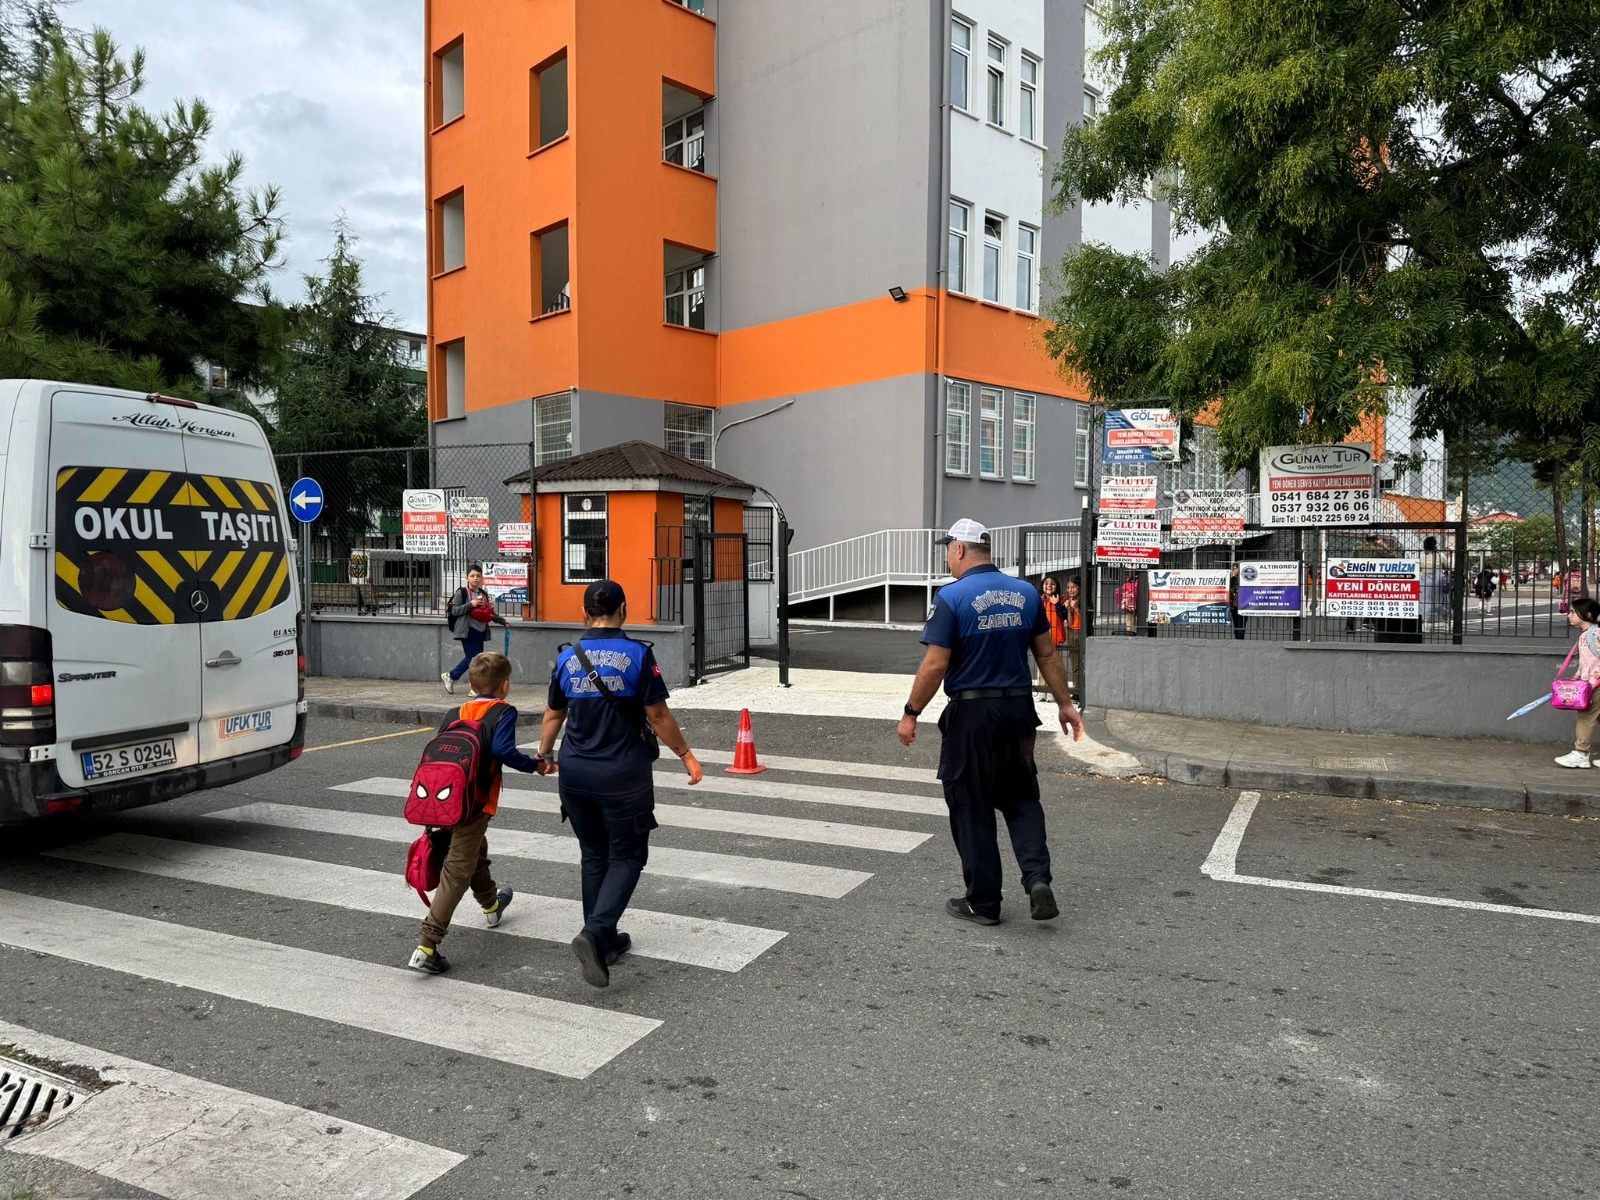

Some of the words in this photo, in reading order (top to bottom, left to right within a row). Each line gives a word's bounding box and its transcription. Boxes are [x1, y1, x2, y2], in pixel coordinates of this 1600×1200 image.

[112, 413, 176, 430] Allah
[176, 419, 238, 438] Korusun
[1280, 453, 1328, 465] GÜNAY
[1333, 450, 1361, 462] TUR
[1271, 492, 1301, 502] 0541
[1306, 491, 1330, 501] 684
[1334, 490, 1349, 500] 27
[1354, 490, 1369, 500] 36
[1271, 503, 1302, 513] 0537
[1306, 503, 1330, 512] 932
[1333, 502, 1349, 511] 06
[1354, 502, 1369, 511] 06
[1300, 514, 1322, 523] 0452
[1325, 514, 1342, 522] 225
[1344, 513, 1356, 521] 69
[1358, 513, 1370, 521] 24
[74, 506, 173, 541] OKUL
[201, 511, 279, 548] TAŞITI
[1114, 521, 1135, 529] ULU
[1135, 522, 1158, 530] TUR
[1346, 561, 1377, 573] ENGİN
[1378, 562, 1416, 573] TURİZM
[1169, 576, 1197, 586] VİZYON
[1198, 576, 1227, 586] TURİZM
[1336, 581, 1364, 592] YENİ
[1367, 581, 1411, 592] DÖNEM
[978, 612, 1022, 630] ZABITA
[566, 649, 632, 675] BÜÜKŞEHİR
[226, 714, 251, 733] UFUK
[252, 710, 271, 728] TUR
[93, 753, 114, 771] 52
[119, 750, 130, 766] S
[134, 743, 172, 763] 0294
[131, 764, 144, 772] OTO
